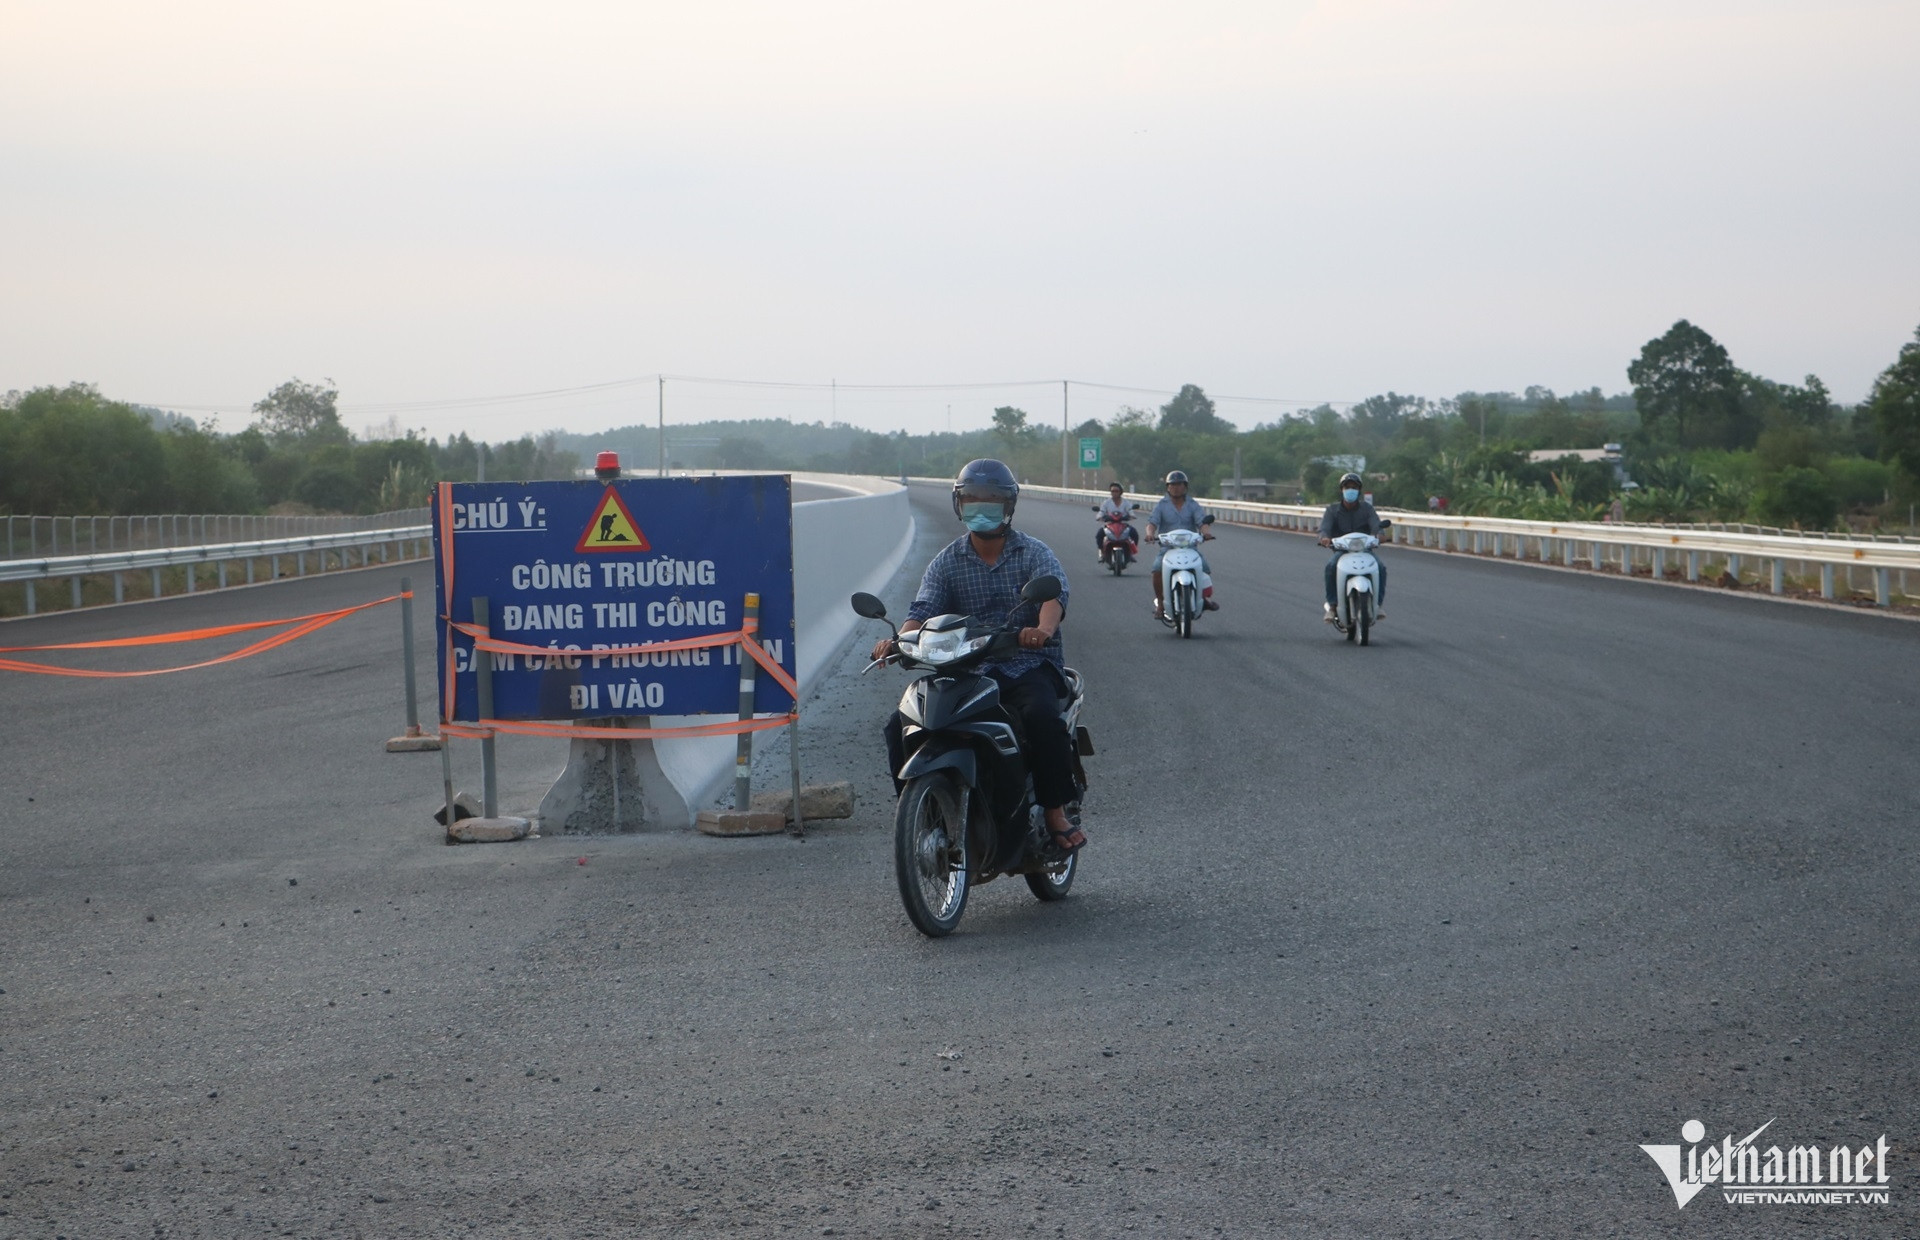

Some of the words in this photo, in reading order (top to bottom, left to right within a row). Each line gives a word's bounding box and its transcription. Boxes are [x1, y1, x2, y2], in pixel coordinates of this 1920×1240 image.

[452, 497, 509, 529] CHÚ
[517, 496, 546, 527] Ý:
[512, 559, 592, 590] CÔNG
[600, 555, 715, 588] TRƯỜNG
[503, 603, 584, 631] ĐANG
[592, 602, 637, 628] THI
[647, 595, 726, 627] CÔNG
[453, 647, 515, 673] CM
[722, 639, 784, 666] TIN
[569, 684, 599, 710] ĐI
[607, 677, 665, 709] VÀO
